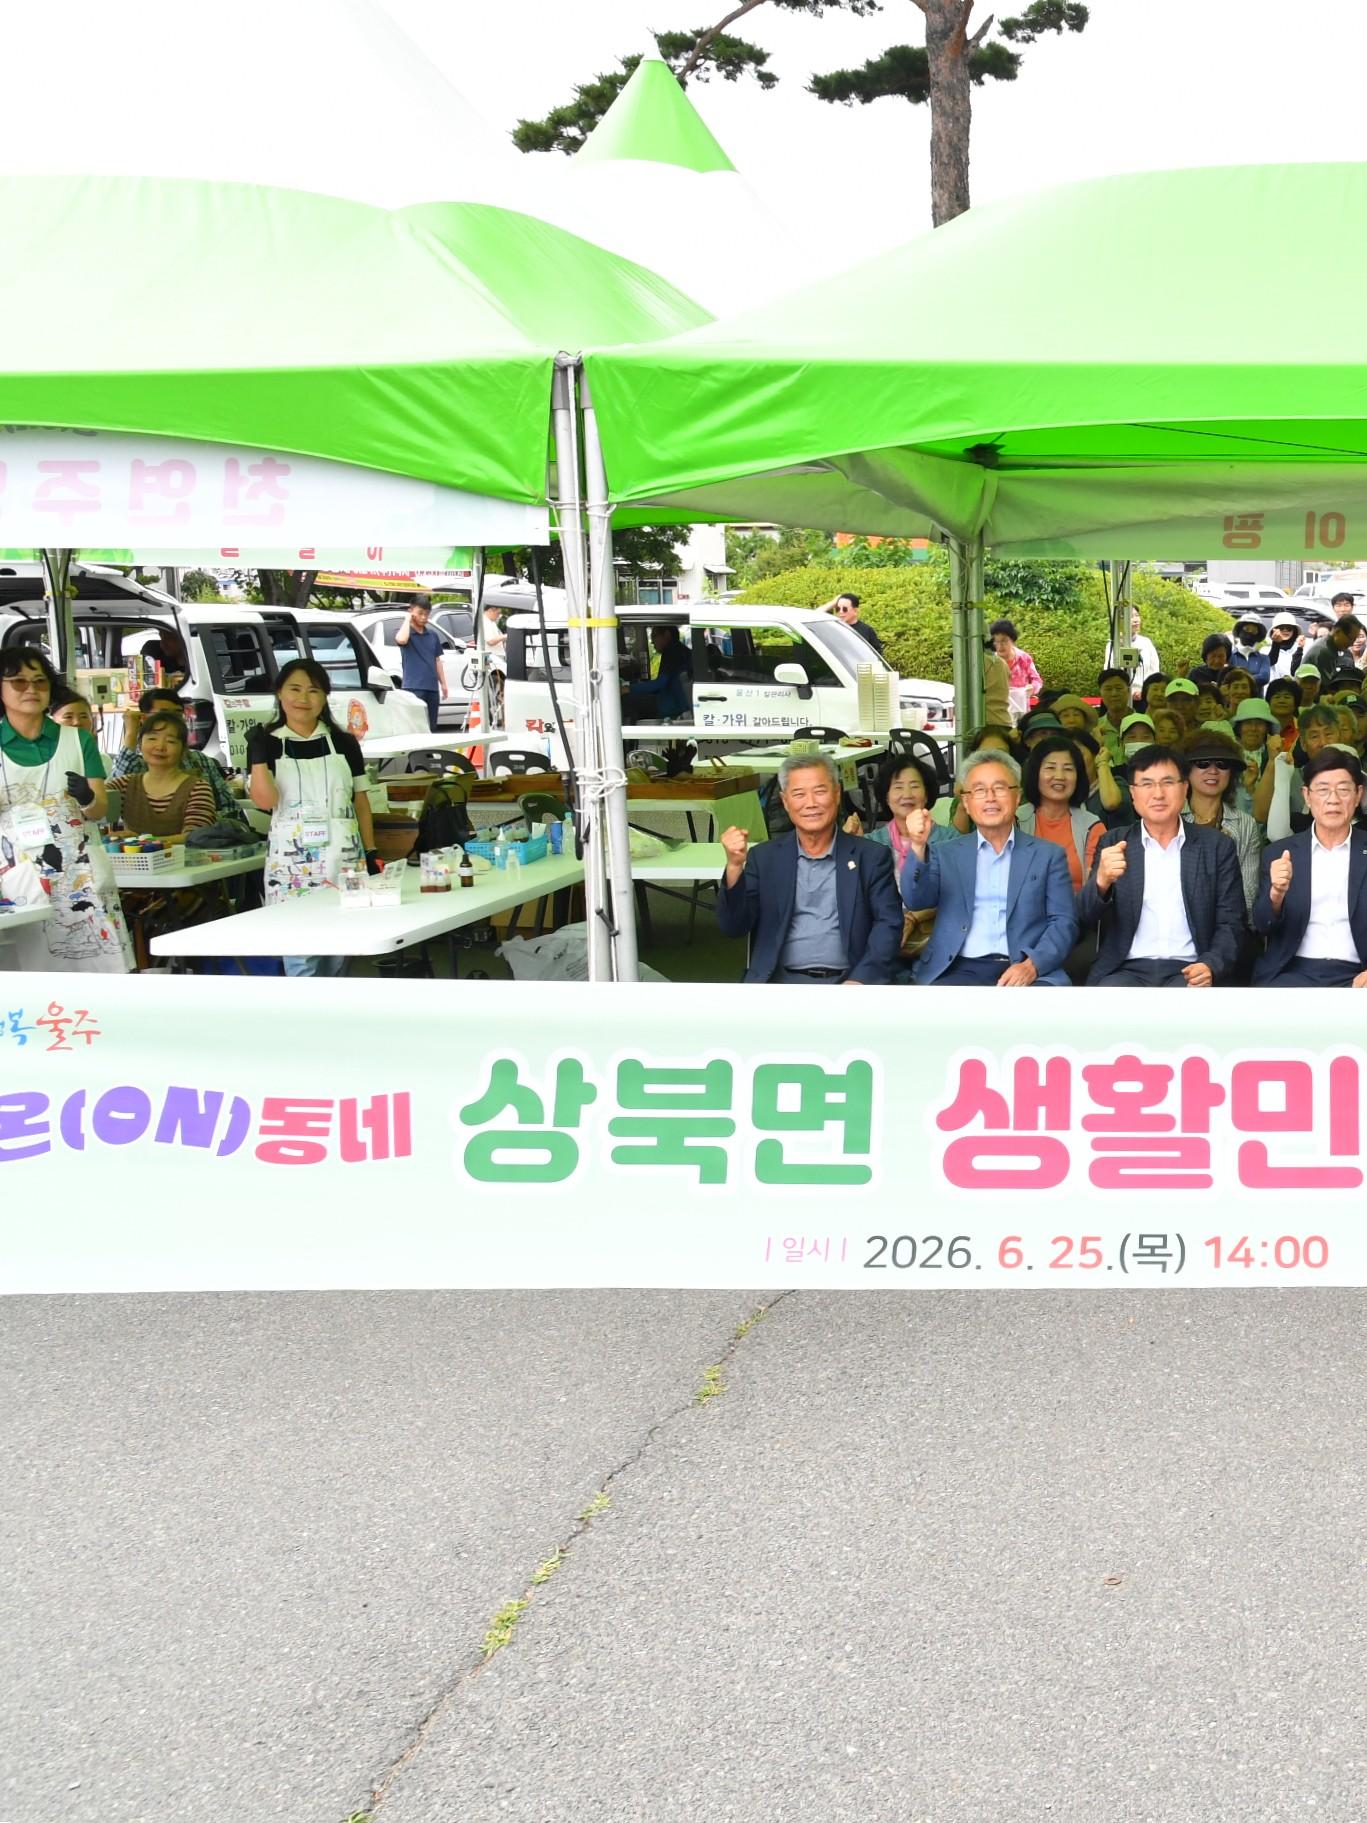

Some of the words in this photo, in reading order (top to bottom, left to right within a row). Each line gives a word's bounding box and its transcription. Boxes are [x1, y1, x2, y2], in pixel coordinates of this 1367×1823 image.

[459, 1057, 875, 1185] 상북면
[863, 1235, 982, 1269] 2026.
[998, 1235, 1034, 1269] 6.
[1049, 1234, 1188, 1275] 25.(목)
[1204, 1236, 1330, 1269] 14:00
